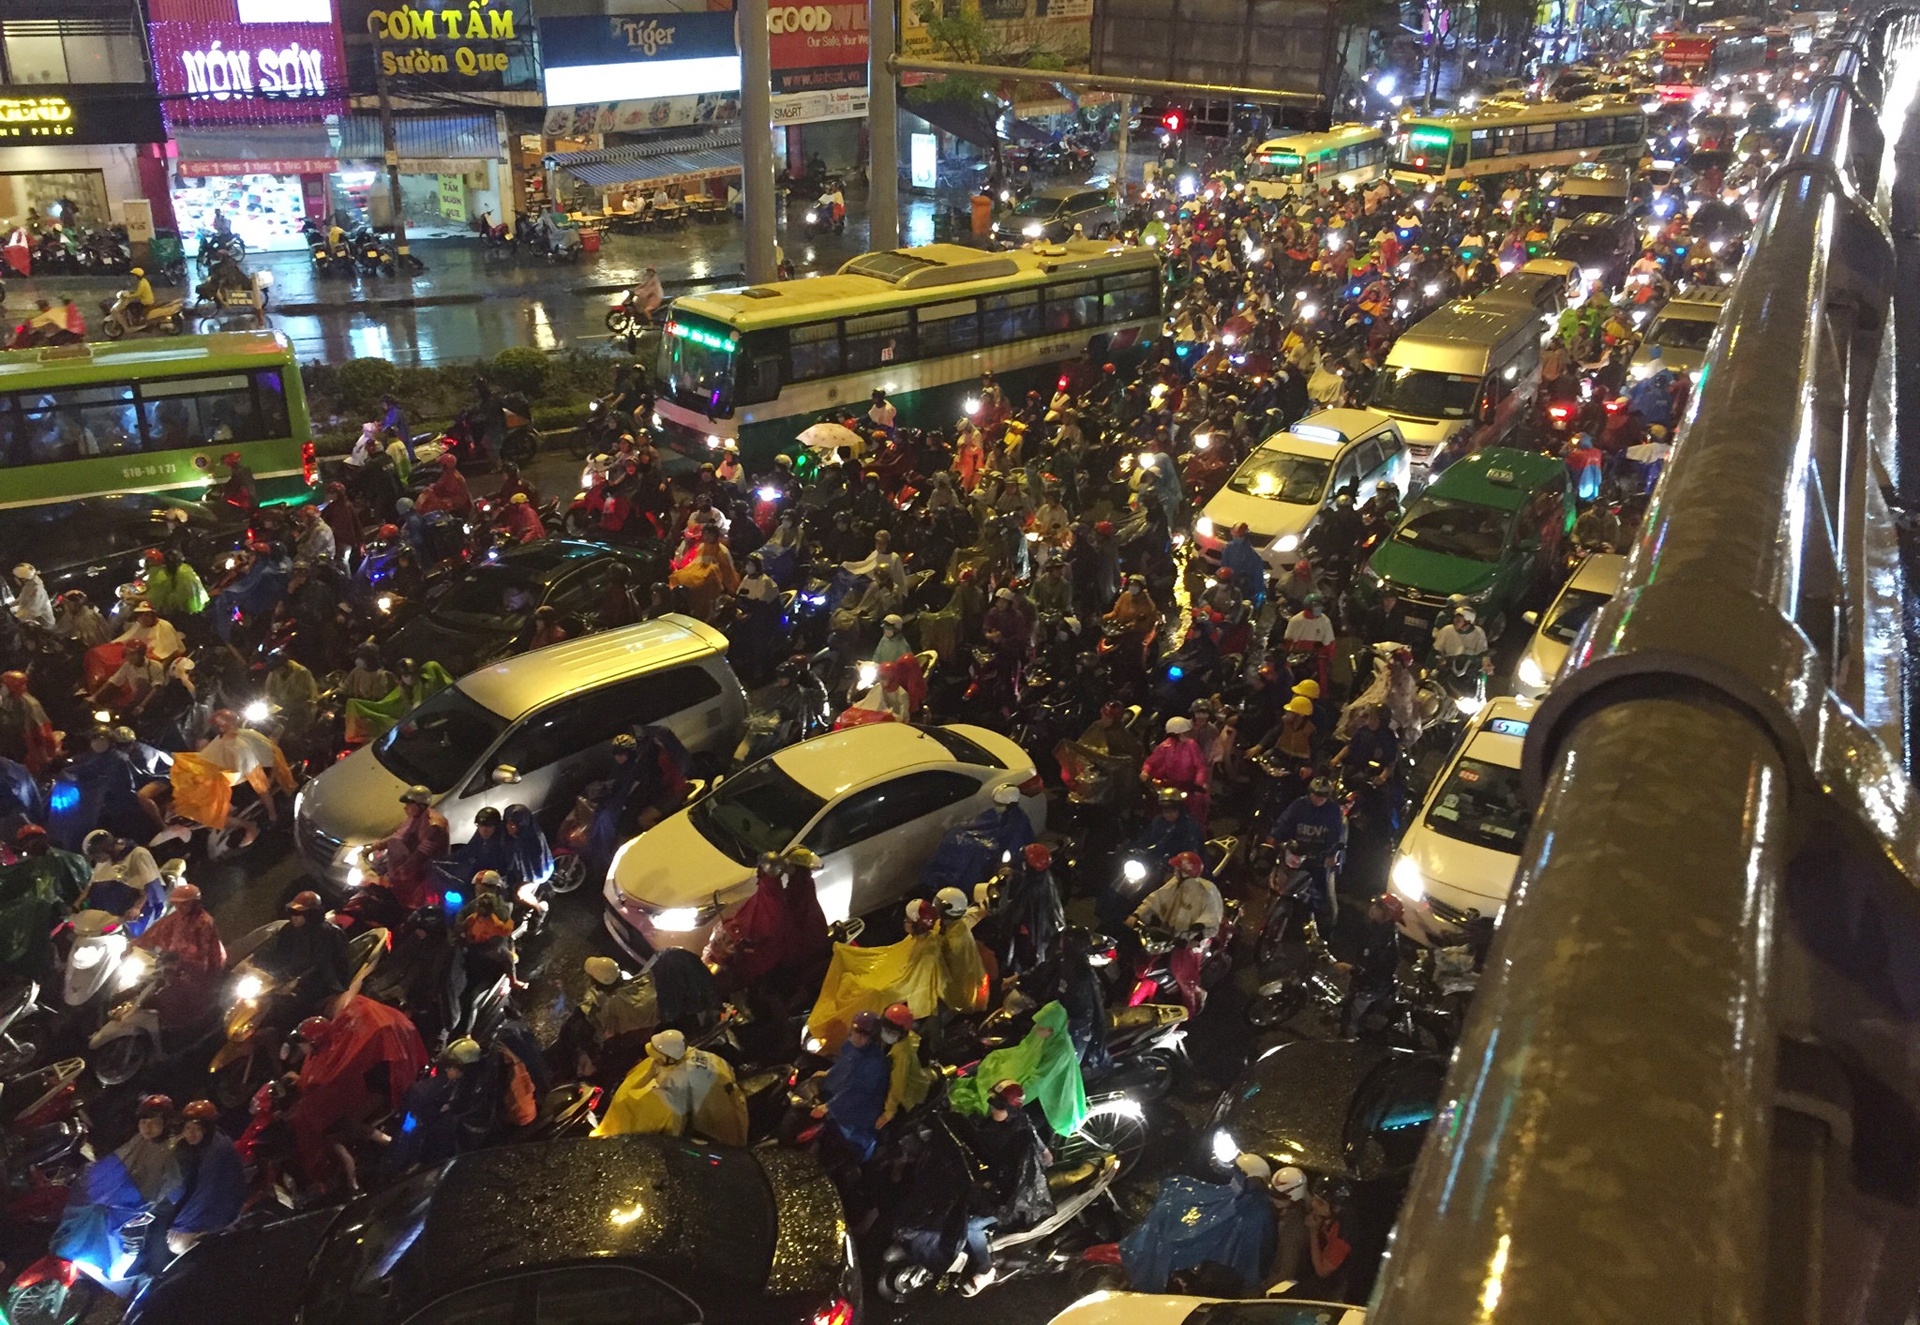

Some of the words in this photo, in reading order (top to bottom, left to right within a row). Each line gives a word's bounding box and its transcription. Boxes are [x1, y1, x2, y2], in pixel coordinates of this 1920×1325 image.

[367, 4, 437, 40] CƠM
[441, 0, 516, 40] TẤM
[623, 19, 676, 57] Tiger
[766, 4, 869, 34] GOODWIL
[182, 40, 255, 101] NÓN
[258, 42, 325, 99] SƠN
[381, 47, 449, 76] Sườn
[455, 46, 508, 76] Que
